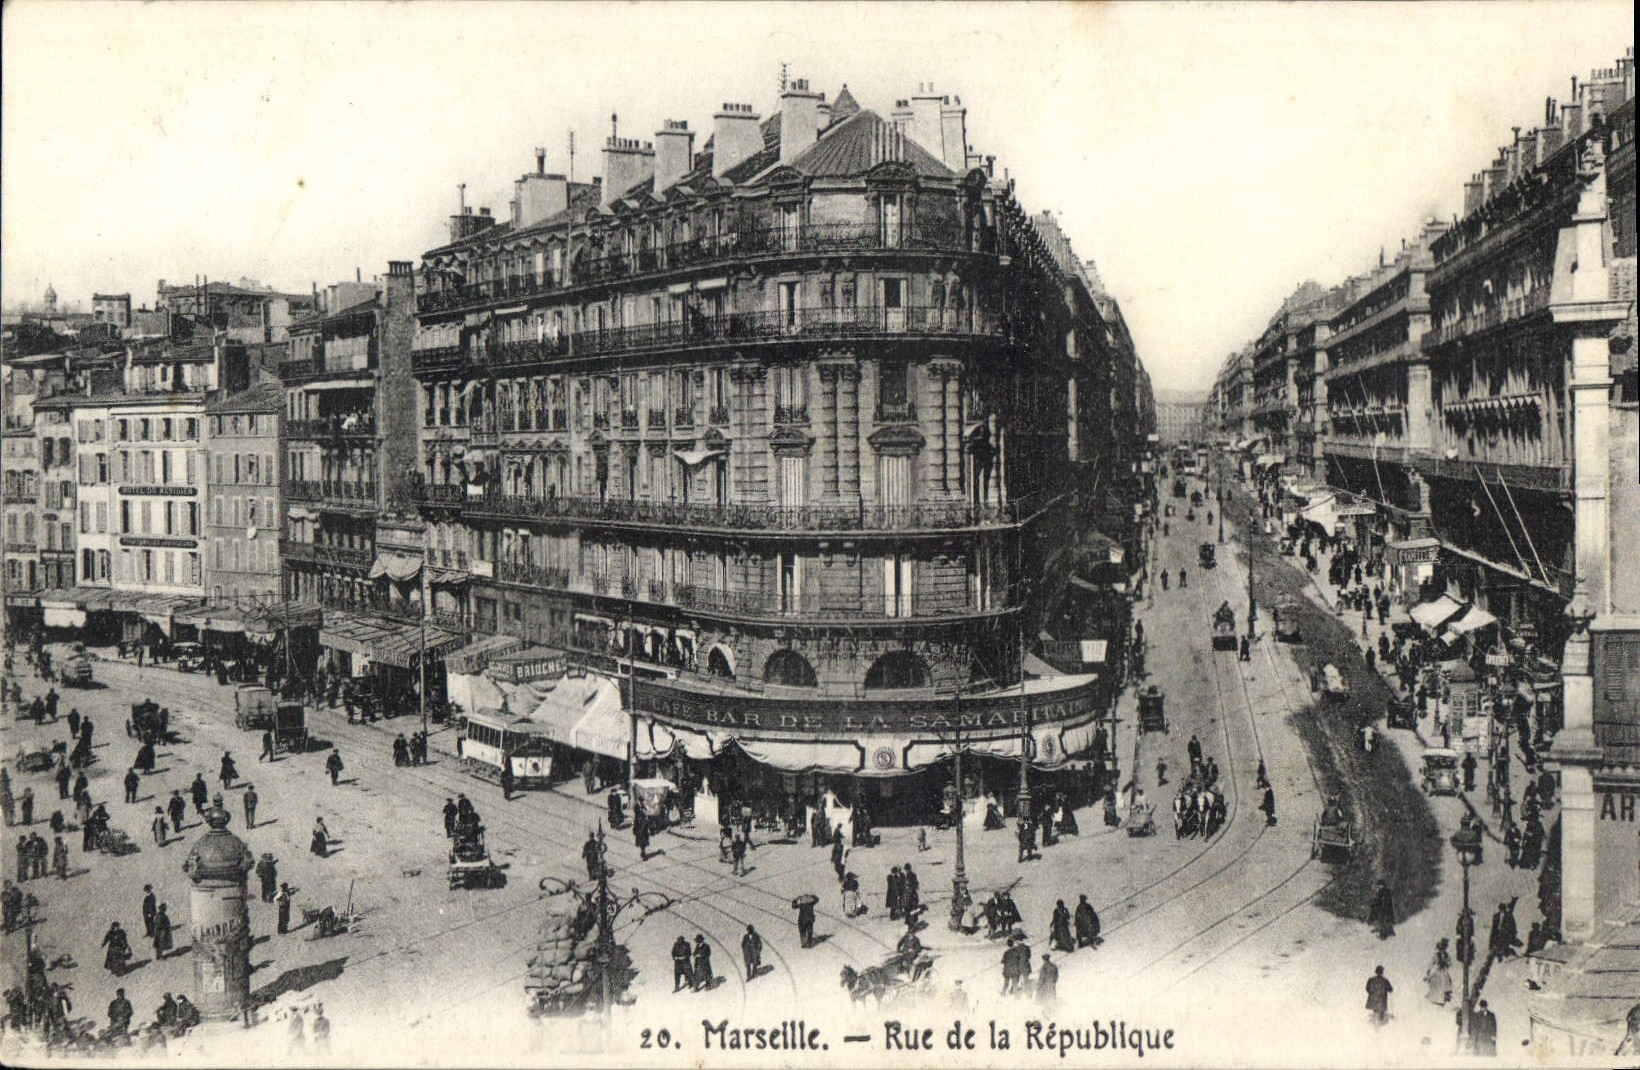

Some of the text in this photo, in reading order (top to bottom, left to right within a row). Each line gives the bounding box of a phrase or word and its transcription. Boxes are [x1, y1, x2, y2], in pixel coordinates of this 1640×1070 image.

[705, 710, 761, 726] BAR
[778, 714, 822, 729] DE
[845, 715, 888, 729] LA
